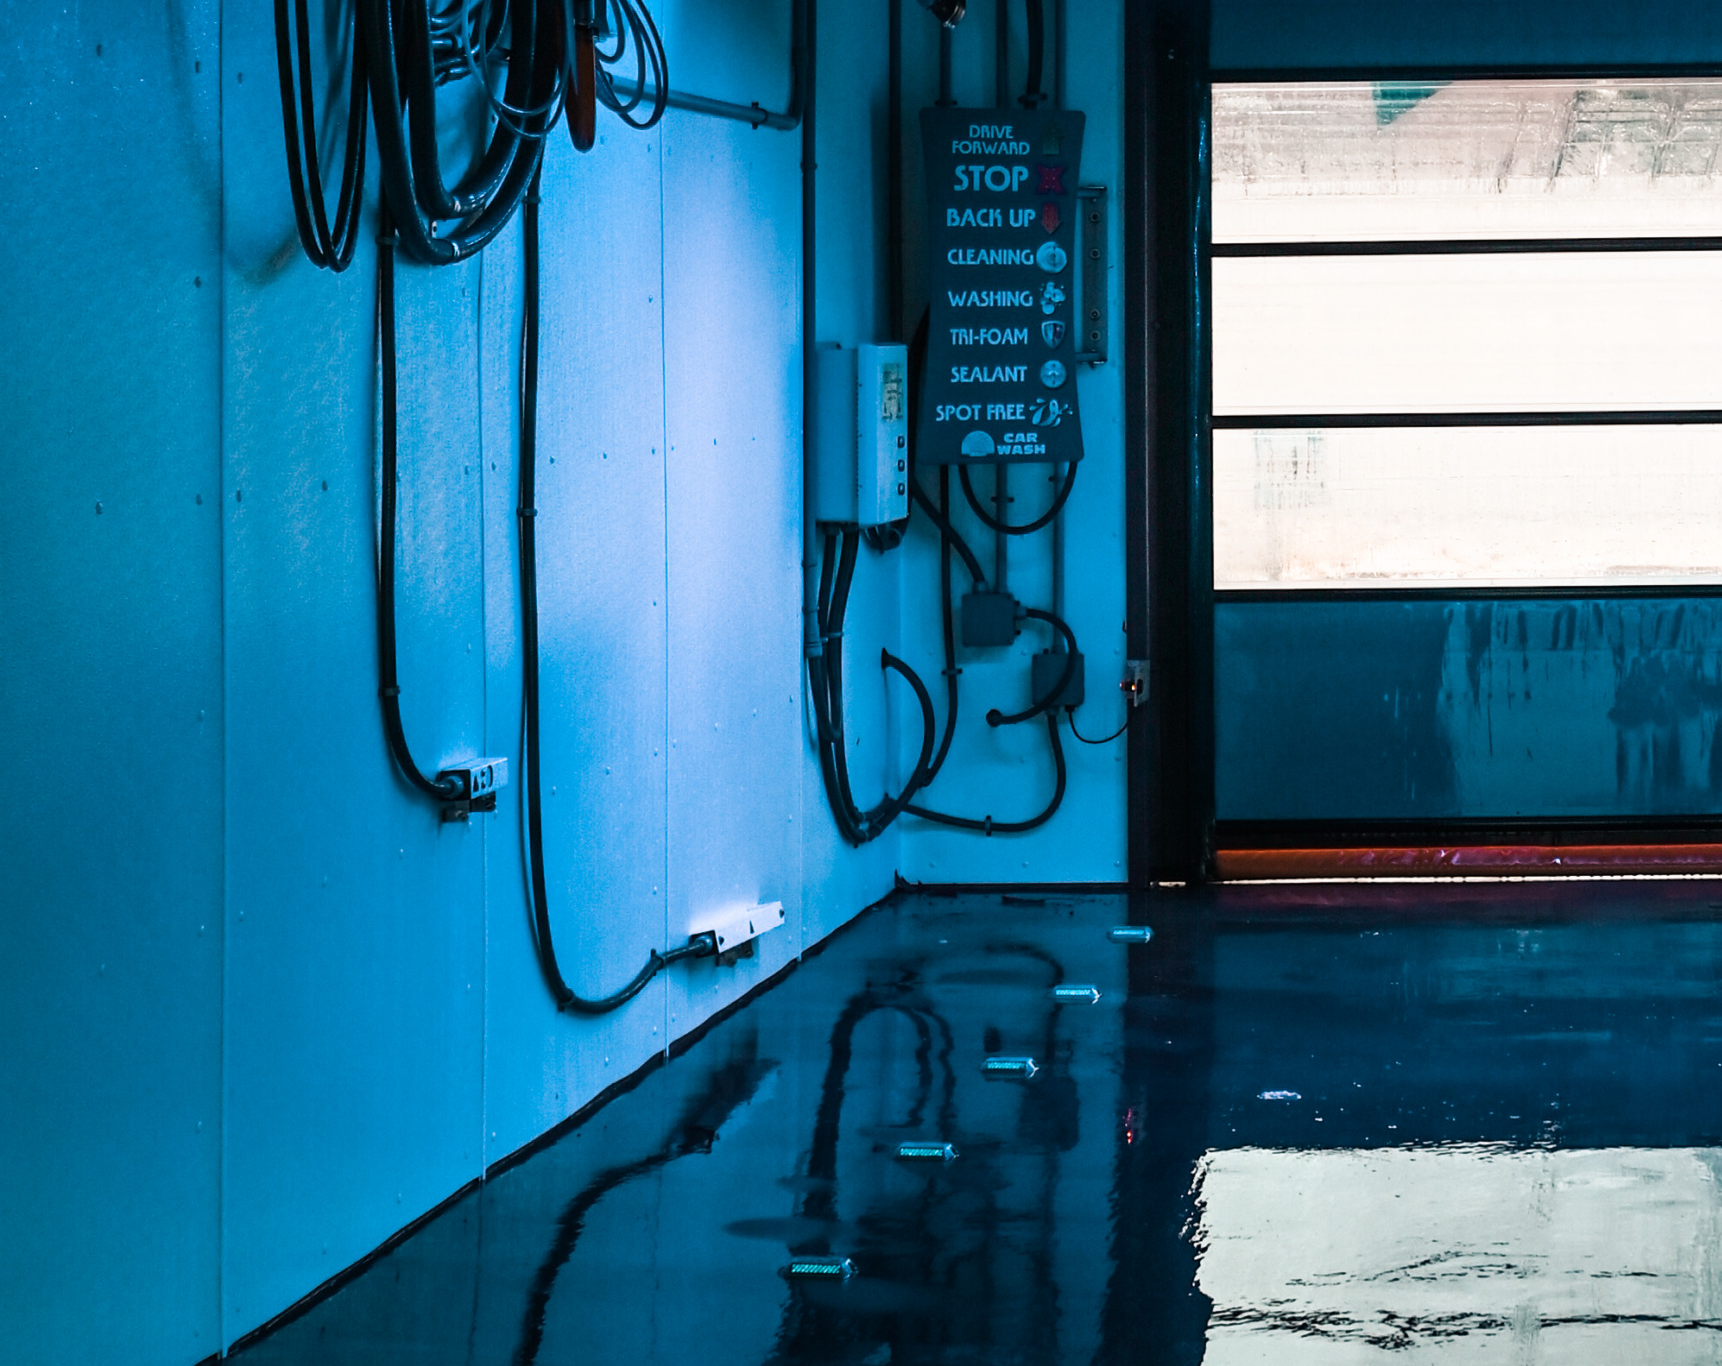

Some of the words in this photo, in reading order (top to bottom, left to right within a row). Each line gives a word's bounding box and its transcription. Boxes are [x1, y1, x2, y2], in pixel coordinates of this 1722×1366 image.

[969, 124, 1013, 139] DRIVE
[952, 140, 1030, 155] FORWARD
[954, 165, 1029, 192] STOP
[946, 208, 1003, 227] BACK
[1009, 209, 1036, 227] UP
[947, 249, 1035, 266] CLEANING
[947, 291, 1033, 308] WASHING
[950, 327, 1029, 346] TRI-FOAM
[950, 366, 1027, 383] SEALANT
[936, 404, 981, 422] SPOT
[986, 404, 1026, 421] FREE
[1003, 433, 1038, 444] CAR
[996, 444, 1046, 456] WASH
